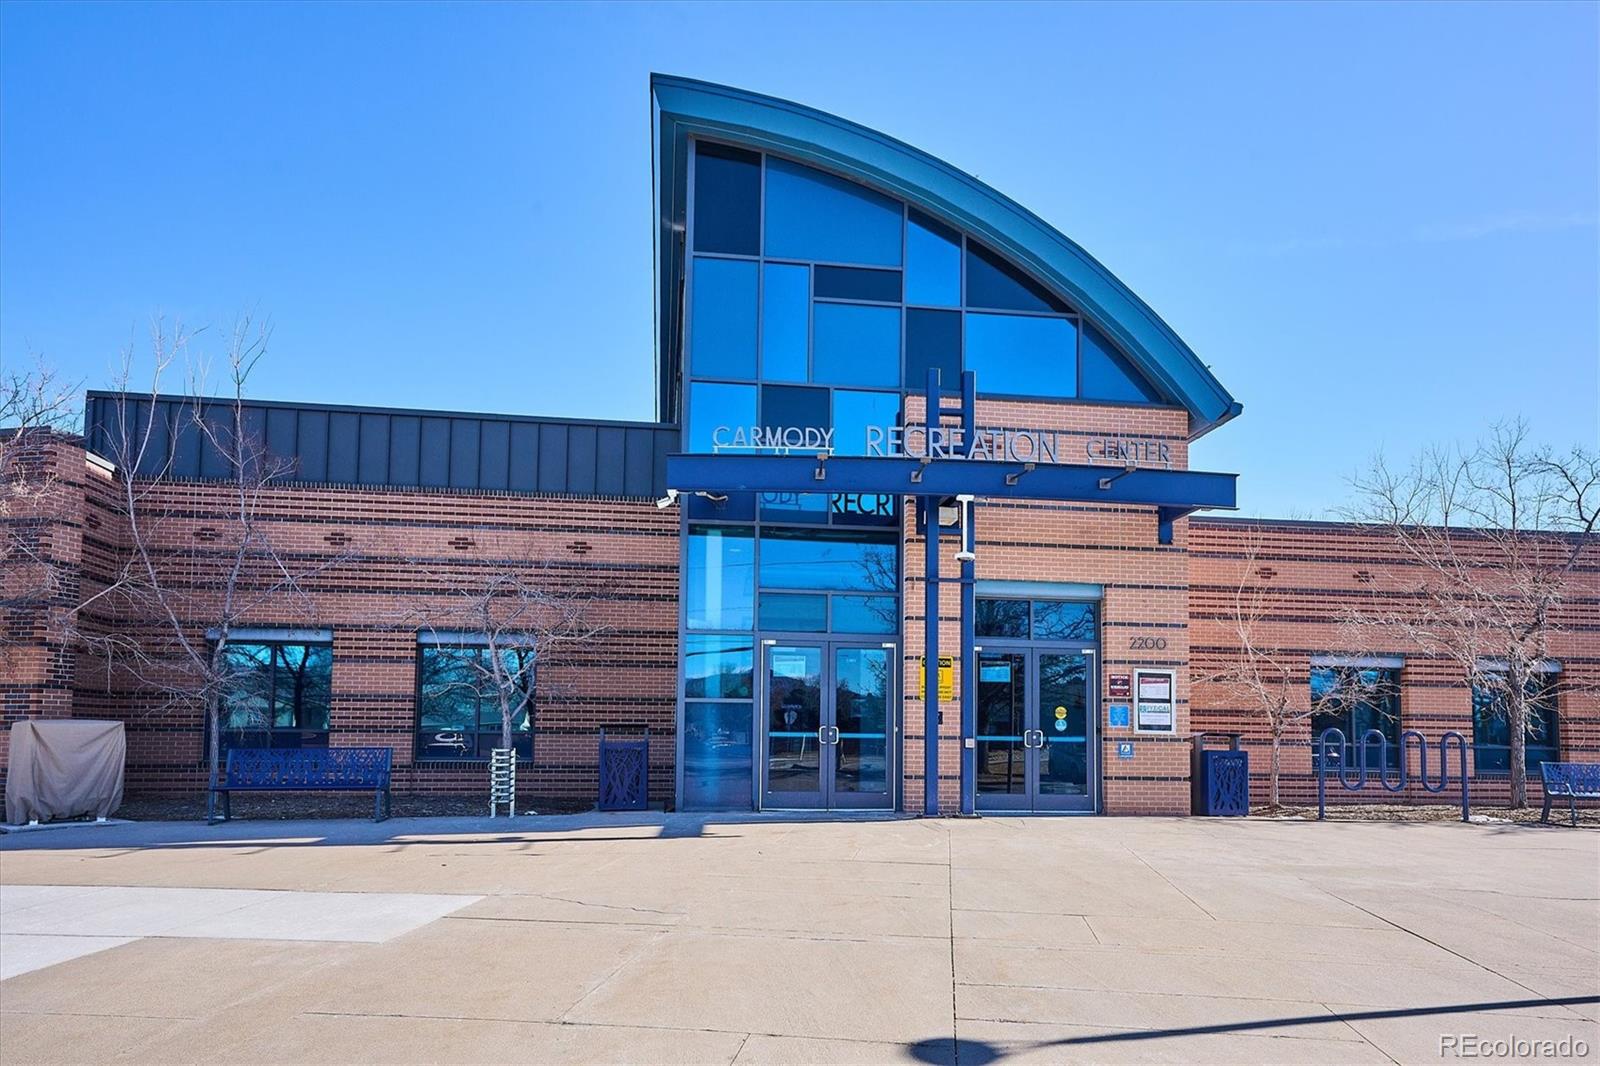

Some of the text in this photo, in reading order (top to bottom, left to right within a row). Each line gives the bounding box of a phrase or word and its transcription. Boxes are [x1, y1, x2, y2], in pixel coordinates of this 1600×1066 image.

[712, 425, 1169, 463] CARMODY RECREATION CENTER
[1129, 637, 1167, 650] 2200
